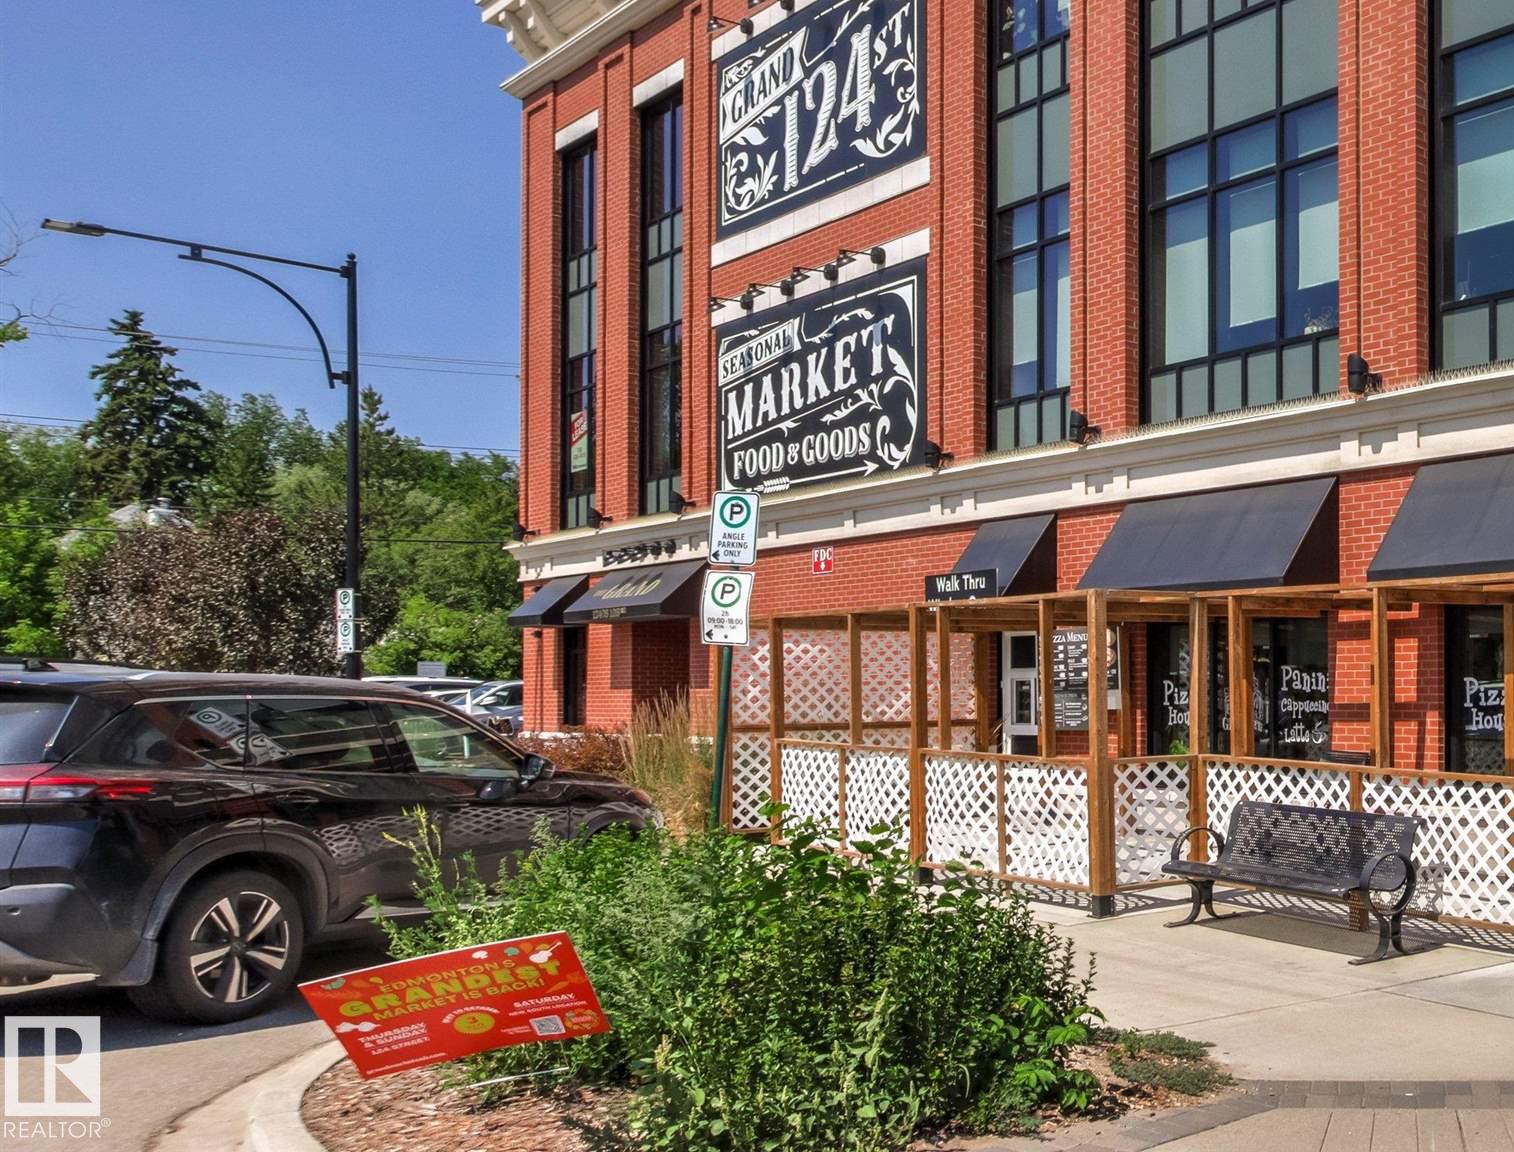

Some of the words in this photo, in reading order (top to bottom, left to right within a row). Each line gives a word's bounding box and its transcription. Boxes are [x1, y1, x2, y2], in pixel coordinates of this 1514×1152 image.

[731, 46, 795, 124] GRAND
[783, 23, 876, 192] 124
[873, 2, 911, 69] ST
[722, 327, 792, 379] SEASONAL
[726, 314, 896, 440] MARKET
[733, 442, 785, 480] FOOD
[787, 443, 800, 465] &
[801, 422, 871, 466] GOODS
[717, 540, 748, 550] PARKING
[722, 532, 745, 541] ANGLE
[723, 549, 742, 558] ONLY
[814, 547, 832, 562] FDC
[936, 575, 960, 593] Walk
[962, 574, 986, 591] Thru
[1052, 634, 1067, 644] ZZA
[1163, 680, 1190, 706] Piz
[1168, 706, 1190, 726] Hou
[1471, 707, 1505, 731] Hou
[1284, 722, 1310, 743] Latte
[339, 959, 561, 1017] GRANDEST
[372, 994, 457, 1021] MARKET
[463, 990, 483, 1001] IS
[487, 978, 545, 996] BACK!
[513, 992, 576, 1009] SATURDAY
